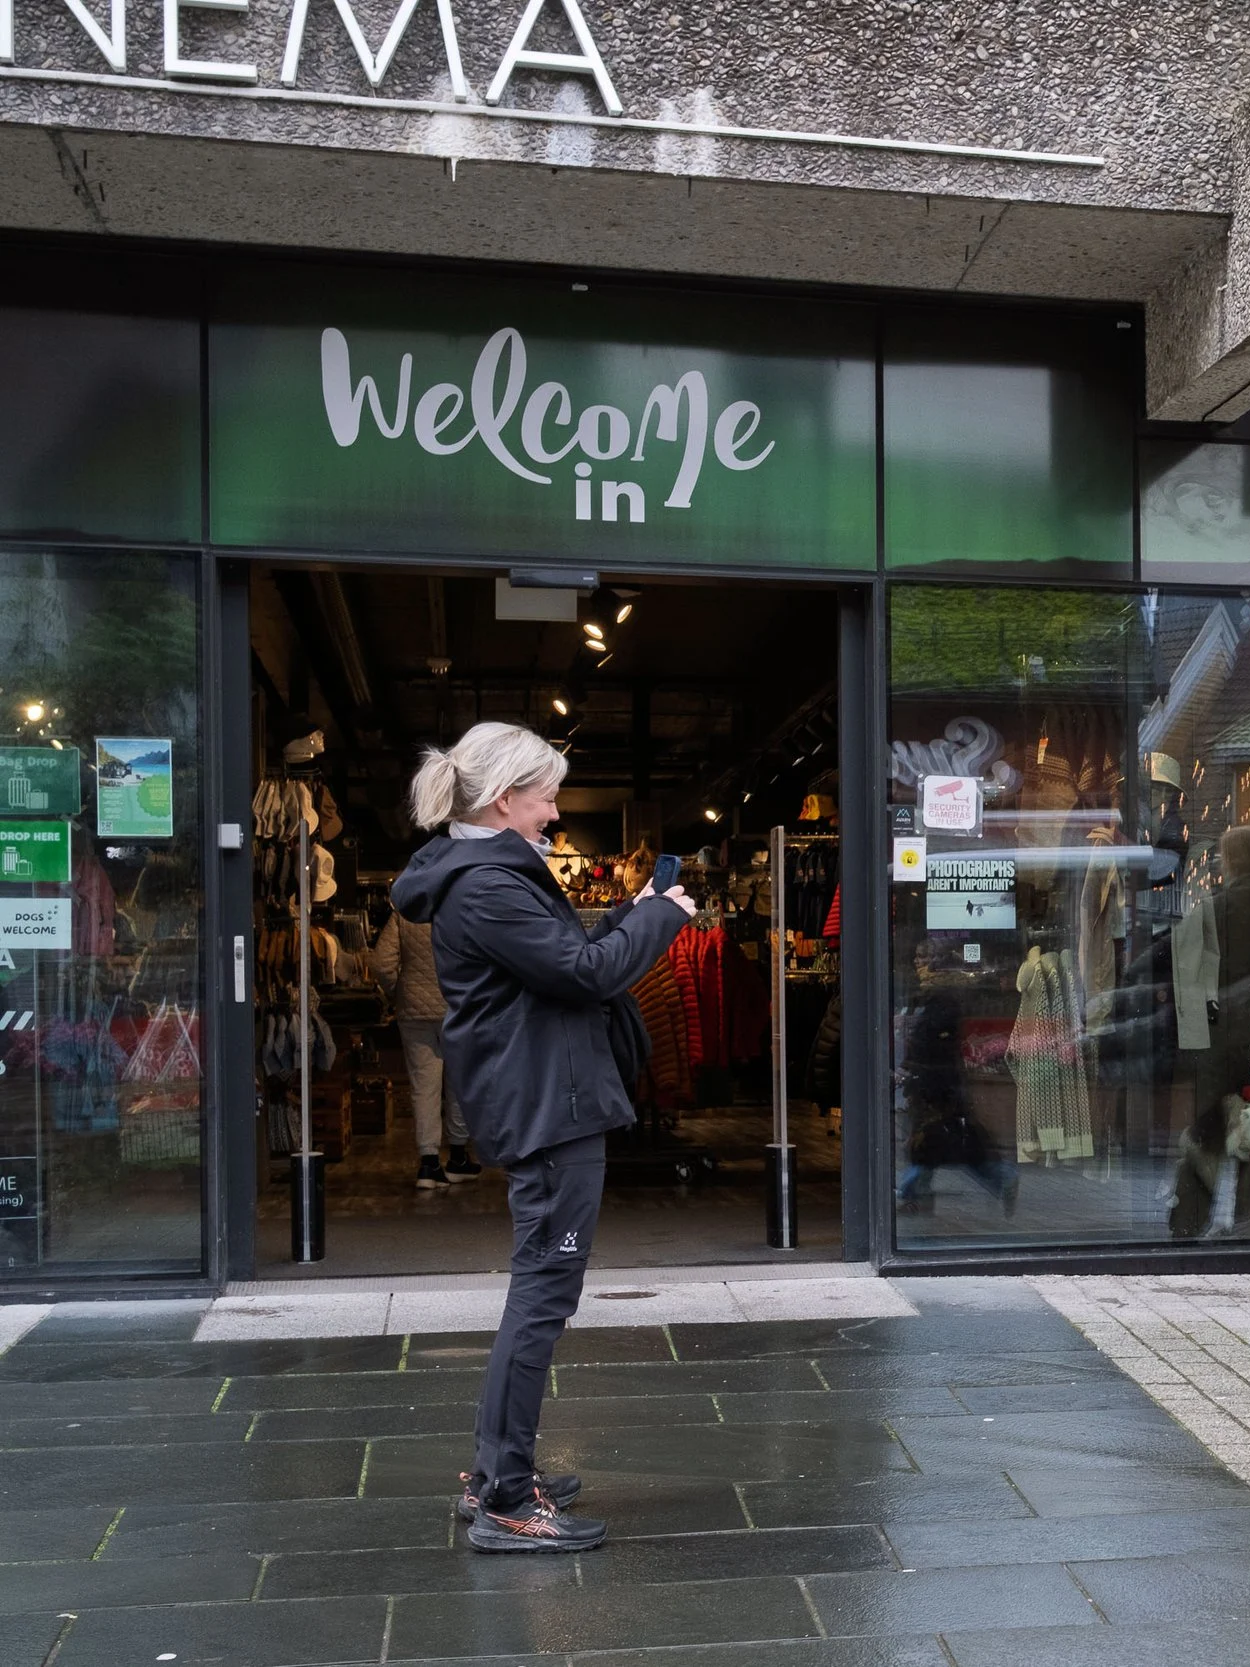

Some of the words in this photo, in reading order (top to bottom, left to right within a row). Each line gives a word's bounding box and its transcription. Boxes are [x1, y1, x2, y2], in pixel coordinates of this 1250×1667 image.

[321, 327, 776, 508] Welcome
[574, 462, 646, 523] in
[28, 756, 57, 768] Drop
[928, 802, 972, 812] SECURITY
[928, 810, 971, 819] CAMERAS
[946, 818, 963, 826] USE
[0, 831, 30, 841] DROP
[33, 831, 61, 841] HERE
[927, 860, 1016, 878] PHOTOGRAPHS
[927, 879, 958, 891] AREN'T
[15, 913, 44, 921] DOGS
[3, 926, 57, 935] WELCOME
